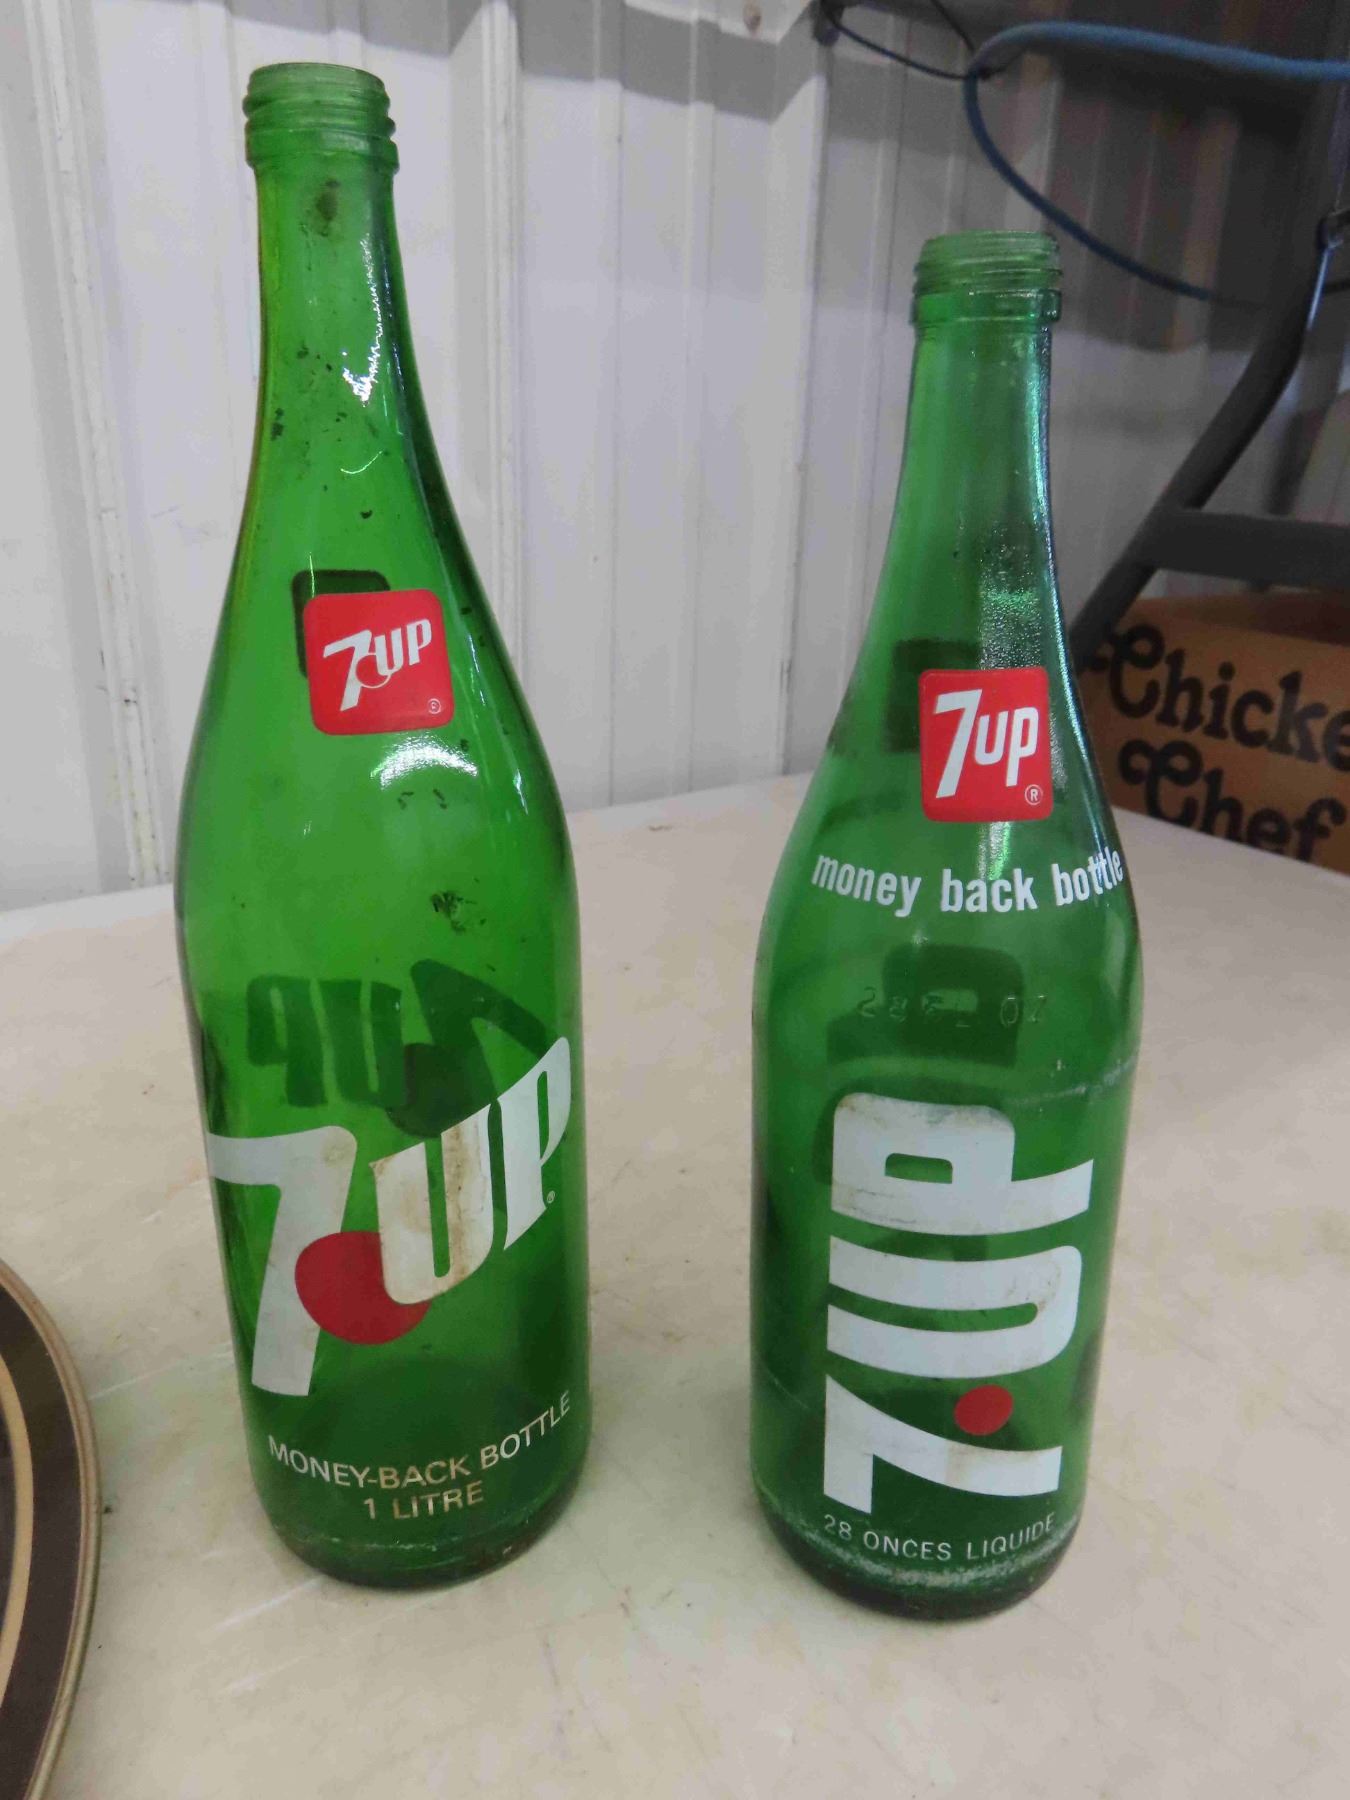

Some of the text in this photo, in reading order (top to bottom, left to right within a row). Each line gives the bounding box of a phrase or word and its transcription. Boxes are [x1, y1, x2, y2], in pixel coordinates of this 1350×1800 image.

[323, 618, 432, 711] 7UP
[1118, 739, 1348, 861] Chef
[811, 846, 1124, 917] money back bottle
[207, 1037, 572, 1396] 7UP
[268, 1390, 571, 1490] MONEY-BACK BOTTLE
[363, 1480, 485, 1520] 1 LITRE
[823, 1511, 1056, 1562] 28 ONCES LIQUIDE
